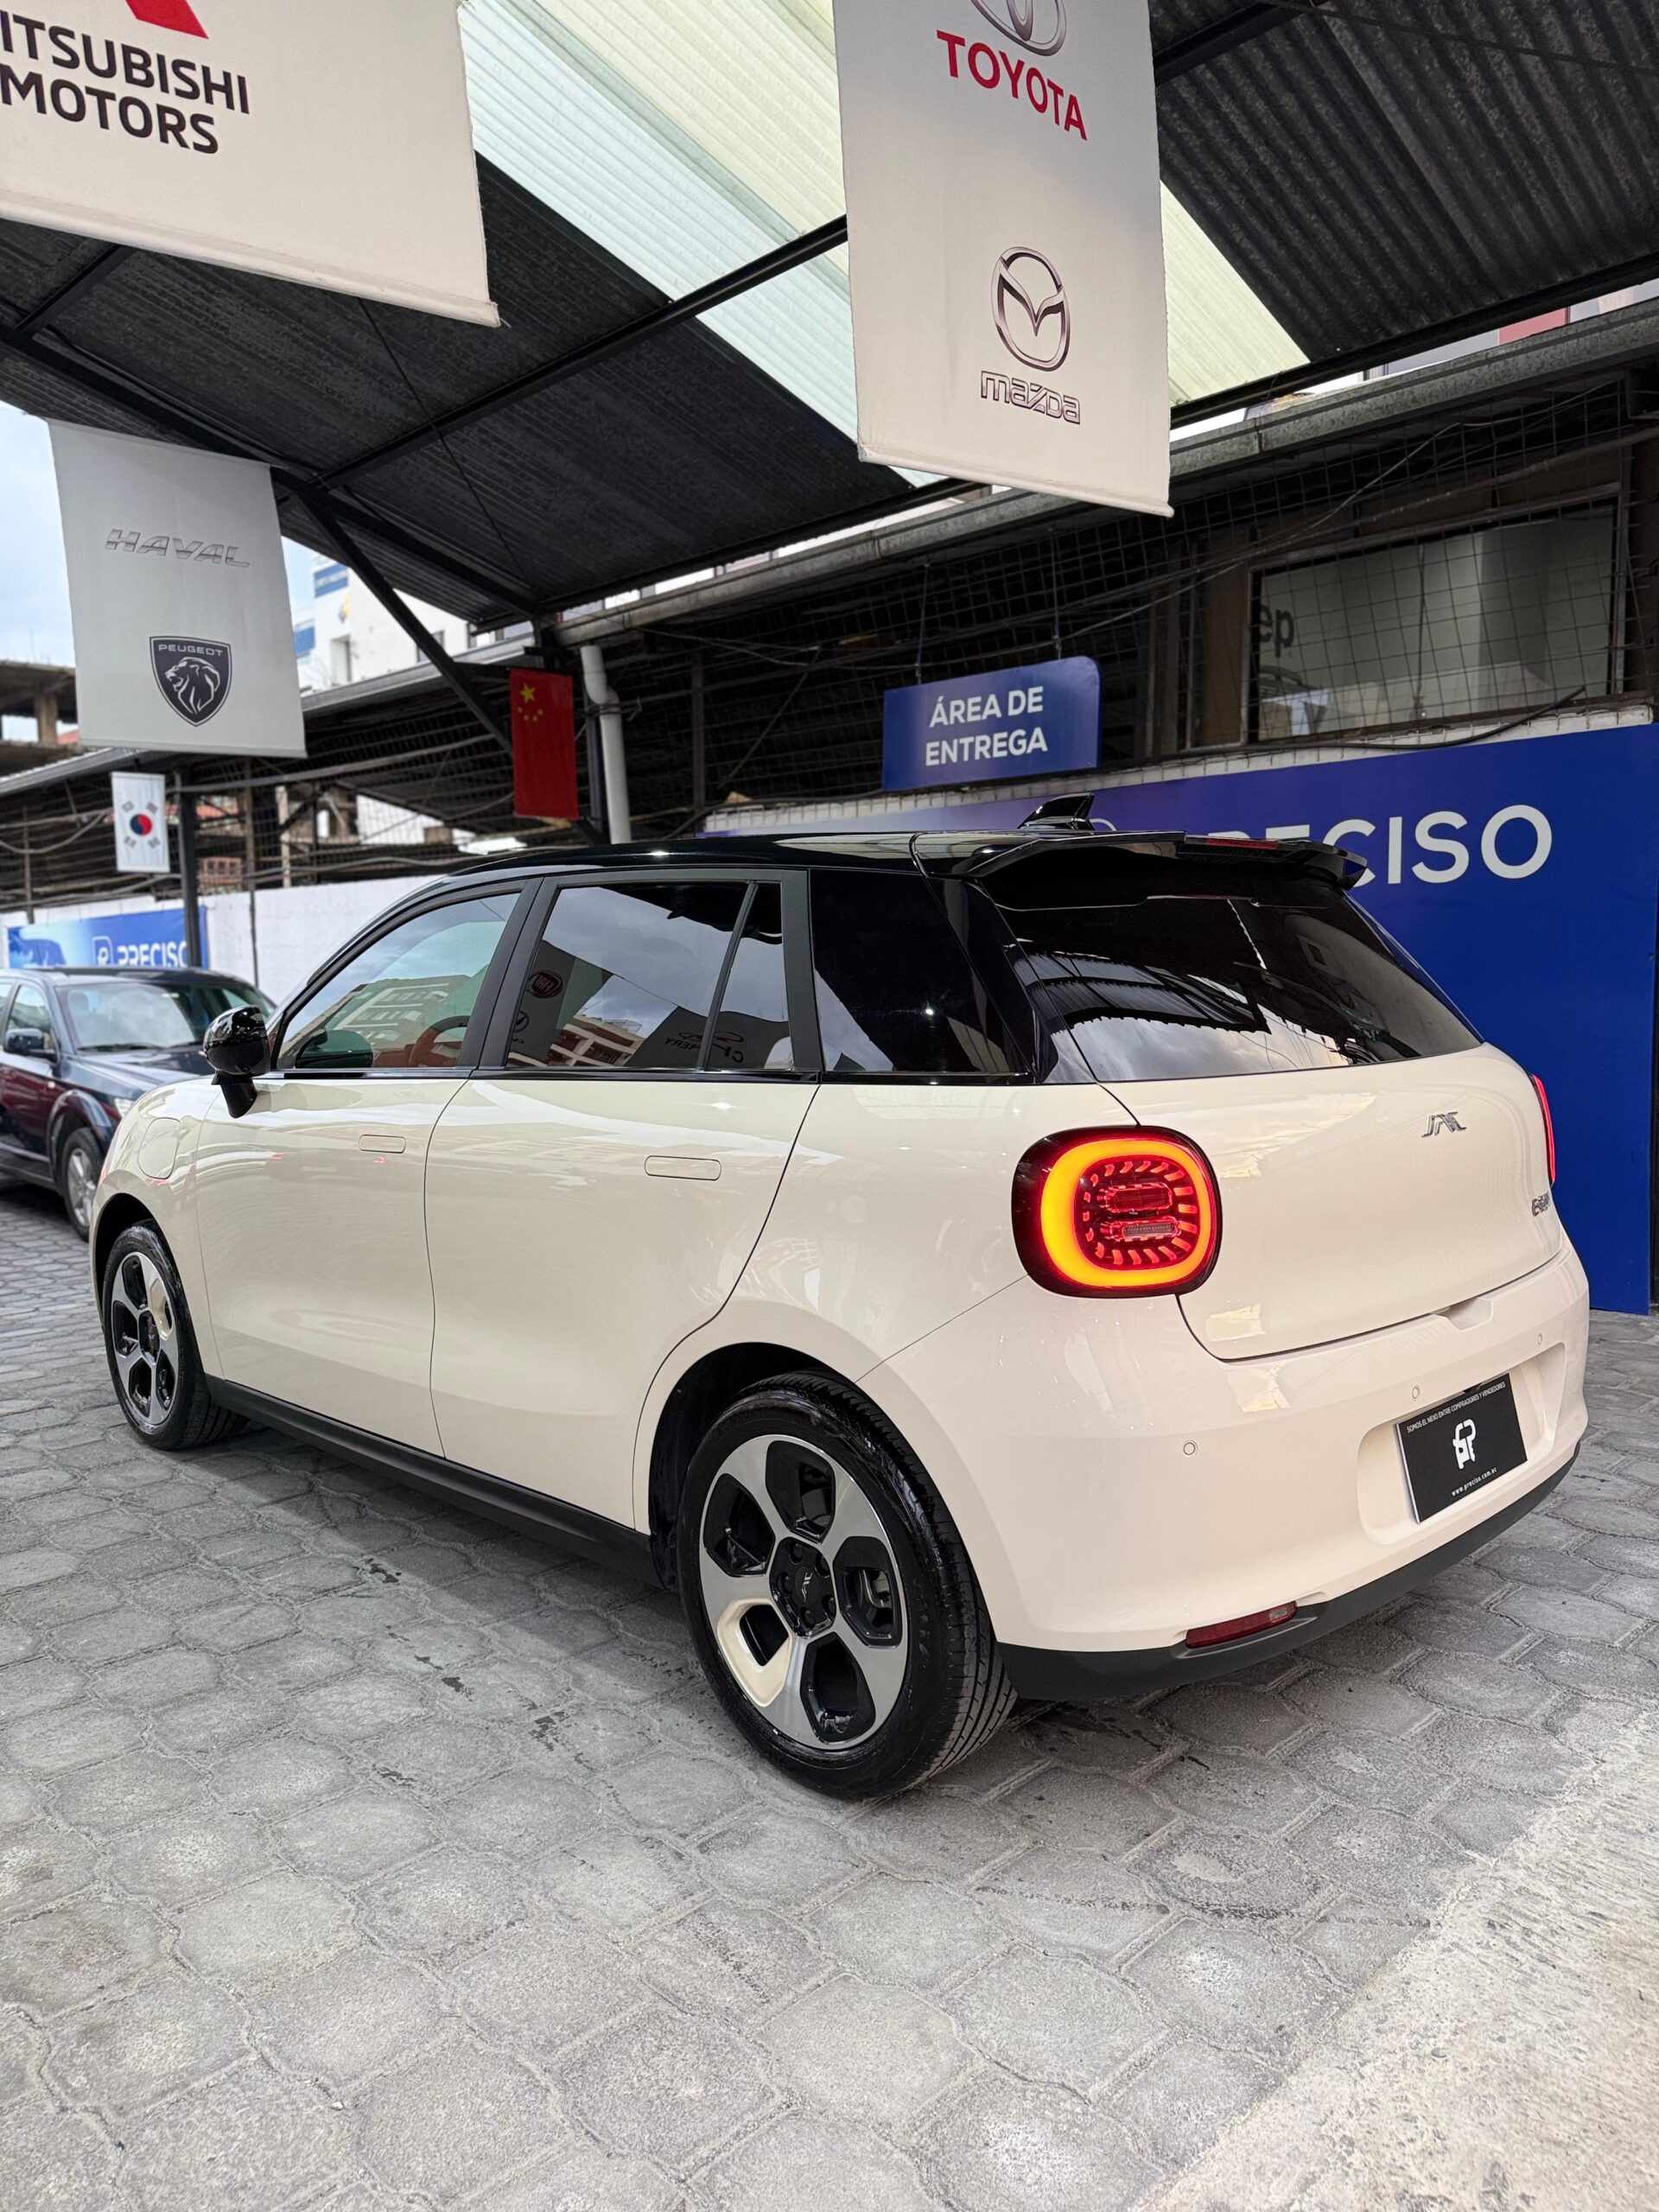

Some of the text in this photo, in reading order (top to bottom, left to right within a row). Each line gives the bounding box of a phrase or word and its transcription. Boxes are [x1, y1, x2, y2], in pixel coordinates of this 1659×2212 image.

[937, 29, 1088, 141] TOYOTA
[0, 63, 219, 154] MOTORS
[105, 529, 251, 568] HAVAL
[158, 644, 224, 657] PEUGEOT
[929, 685, 1044, 728] ÁREA DE
[925, 727, 1048, 766] ENTREGA
[1406, 1421, 1422, 1433] SOMOS
[1438, 1407, 1452, 1420] ENTRE
[1451, 1394, 1480, 1412] COMPRADORES
[1451, 1467, 1497, 1497] www.preciso.com.ec
